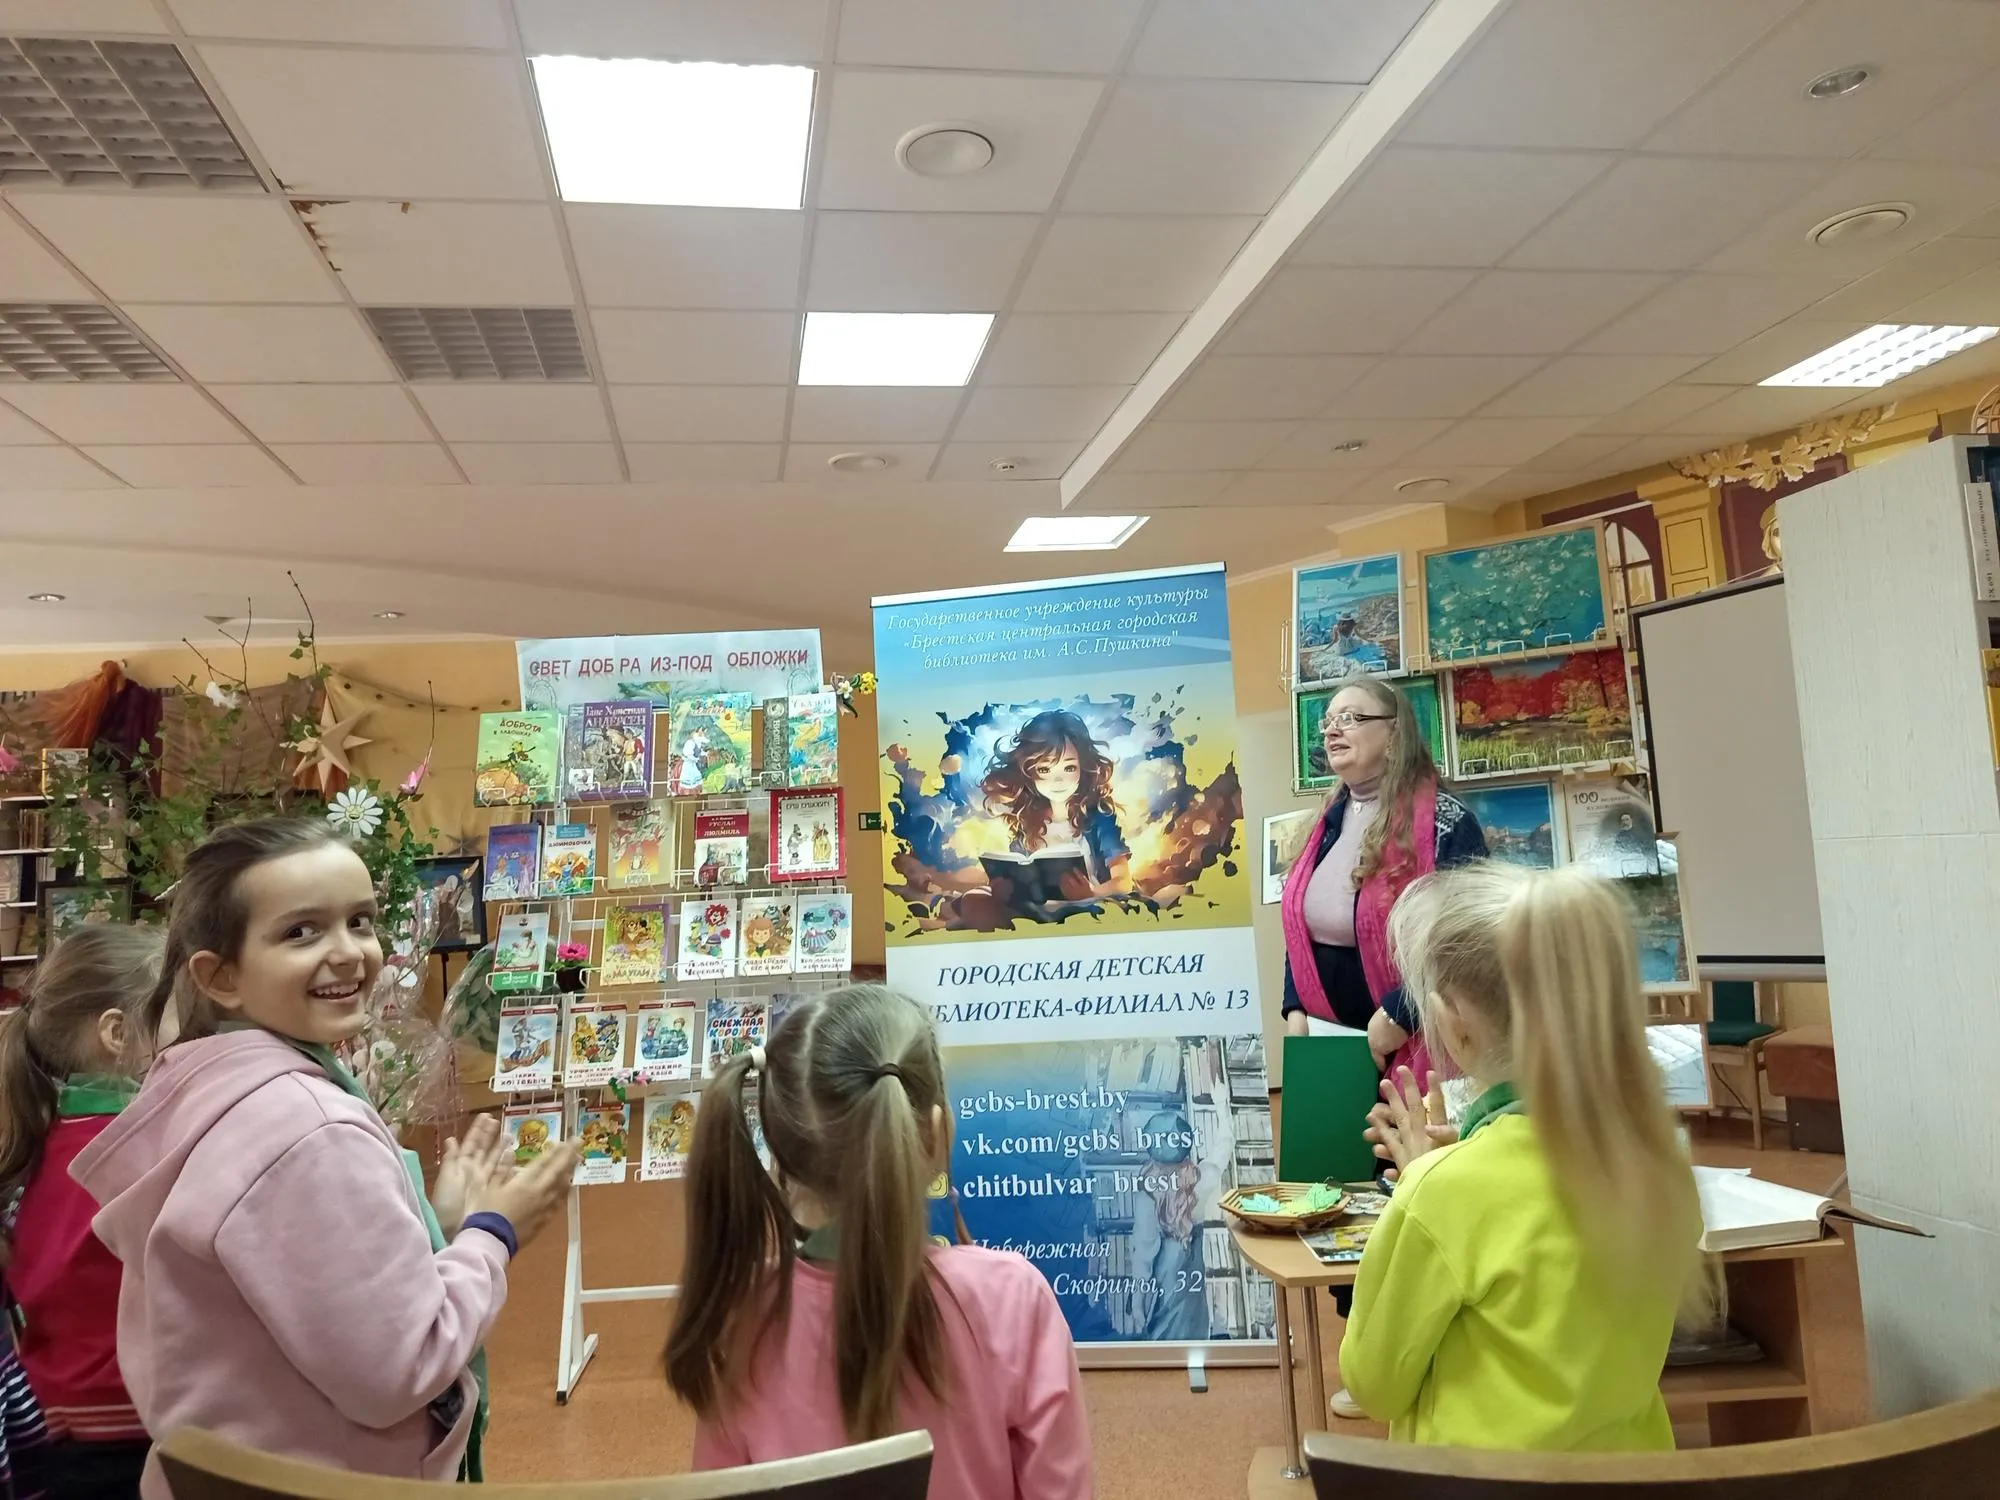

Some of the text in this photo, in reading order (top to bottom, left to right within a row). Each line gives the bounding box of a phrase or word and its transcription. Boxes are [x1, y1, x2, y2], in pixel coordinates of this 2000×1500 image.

[888, 585, 1209, 633] Государственное учреждение культуры
[1001, 619, 1112, 642] центральная
[1117, 610, 1199, 632] городская
[529, 660, 571, 677] СВЕТ
[650, 654, 713, 673] ИЗ-ПОД
[727, 649, 809, 668] ОБЛОЖКИ
[924, 649, 1017, 670] библиотека
[1023, 648, 1051, 660] им.
[500, 717, 542, 732] ДОБРОТА
[585, 715, 647, 729] АНДЕРСЕН
[1573, 791, 1599, 804] 100
[704, 829, 741, 837] ЛЮДМИЛА
[937, 953, 1205, 987] ГОРОДСКАЯ ДЕТСКАЯ
[930, 989, 1250, 1023] БЛИОТЕКА-ФИЛИАЛ № 13
[709, 1026, 765, 1038] КОРОЛЕВА
[712, 1016, 764, 1028] СНЕЖНАЯ
[959, 1086, 1129, 1119] gcbs-brest.by
[962, 1126, 1206, 1158] vk.com/gcbs_brest
[963, 1170, 1180, 1200] chitbulvar_brest
[973, 1238, 1112, 1261] бережная
[1053, 1270, 1204, 1302] Скорины, 32
